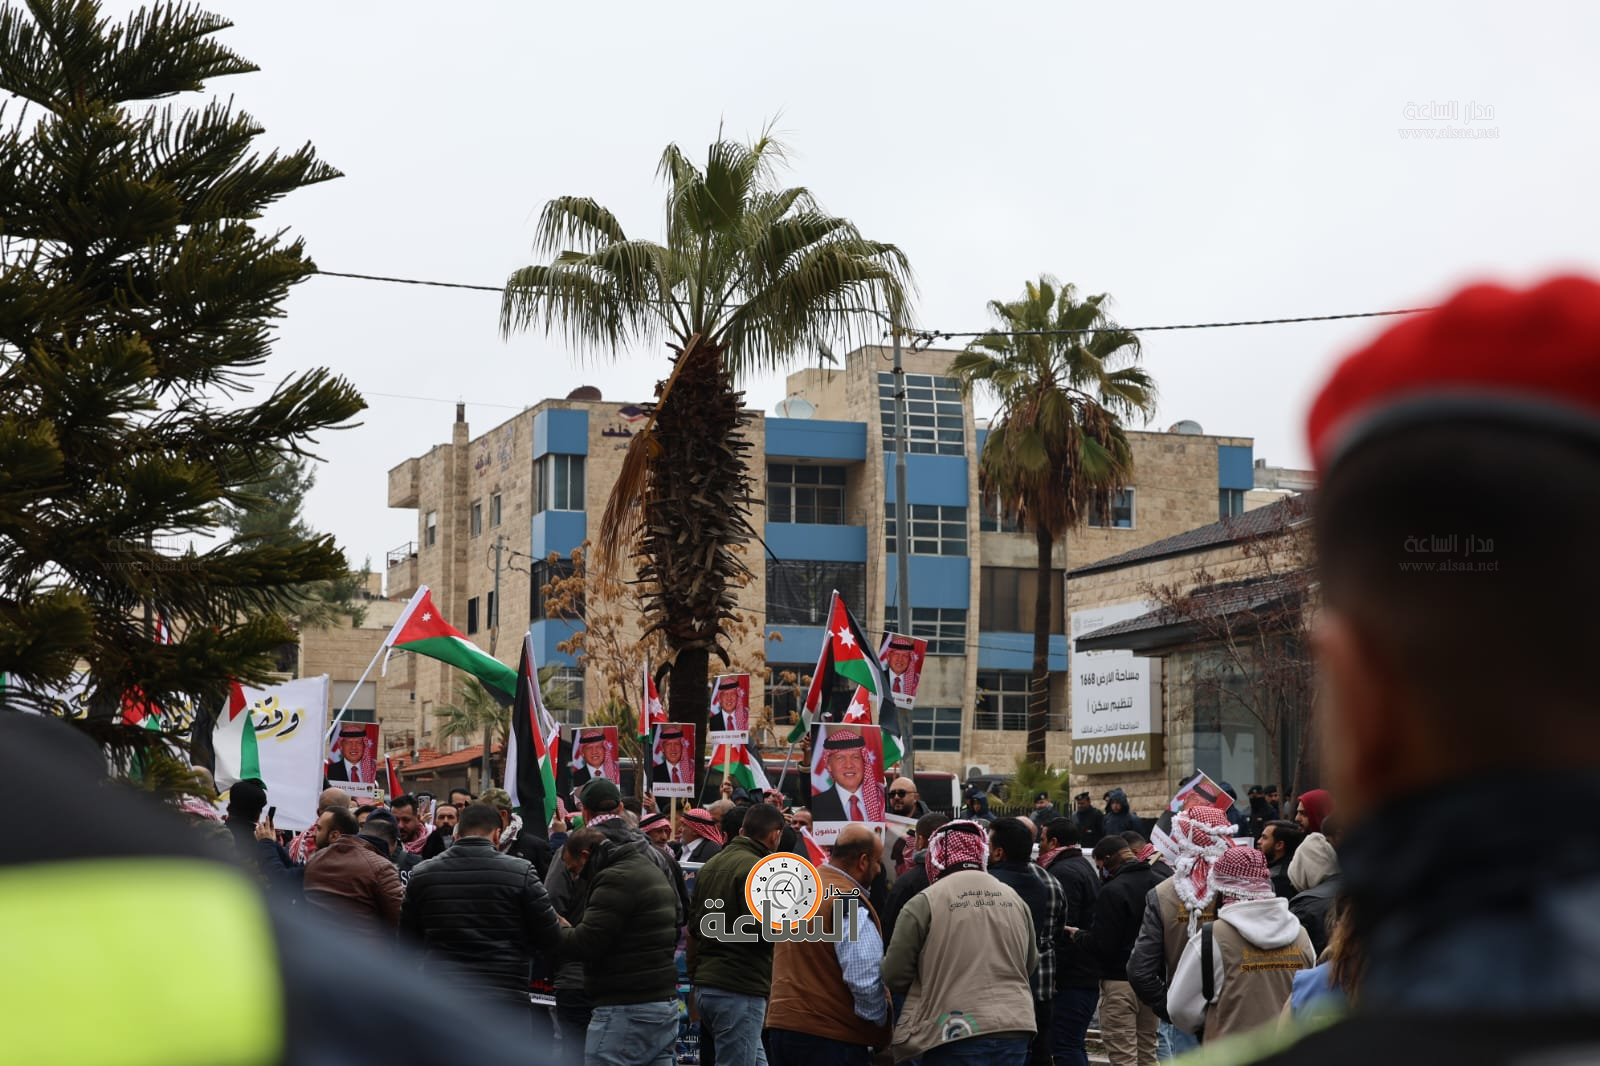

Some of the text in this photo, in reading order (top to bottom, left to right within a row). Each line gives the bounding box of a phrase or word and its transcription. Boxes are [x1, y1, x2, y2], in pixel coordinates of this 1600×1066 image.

[1080, 672, 1095, 686] 1668
[1115, 669, 1140, 681] مساحة
[1092, 700, 1109, 714] سكن
[1111, 697, 1132, 712] تنظيم
[1075, 740, 1146, 765] 0796996444
[815, 828, 837, 836] ماضون
